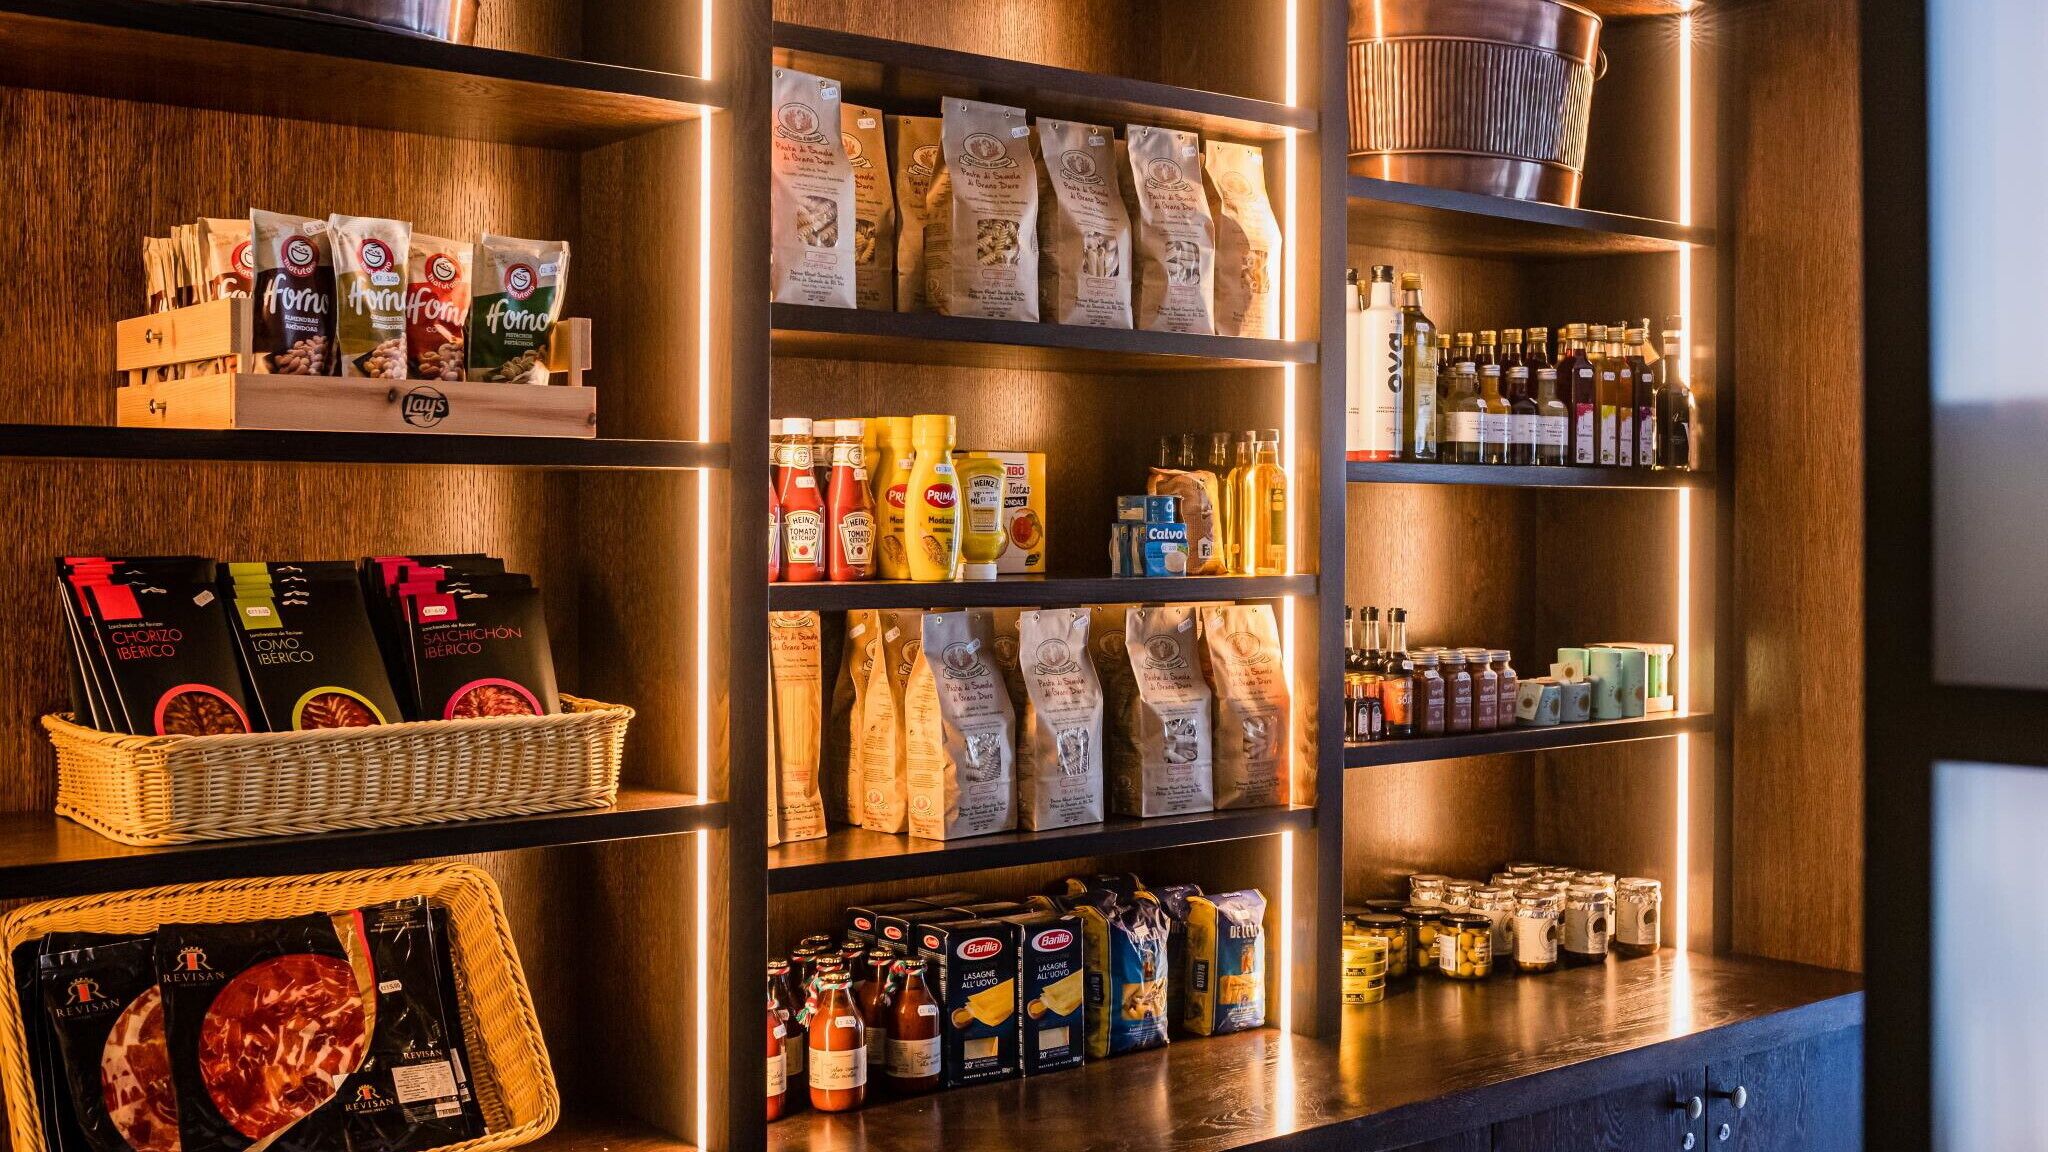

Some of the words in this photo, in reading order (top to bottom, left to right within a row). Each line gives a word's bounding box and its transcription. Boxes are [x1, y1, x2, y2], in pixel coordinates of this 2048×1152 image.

[973, 479, 995, 488] HEINZ
[927, 489, 957, 505] PRIMA
[792, 516, 815, 525] HEINZ
[849, 518, 870, 527] HEINZ
[790, 528, 817, 536] TOMATO
[847, 530, 871, 538] TOMATO
[1148, 527, 1183, 540] Calvo
[112, 628, 183, 645] CHORIZO
[423, 624, 522, 645] SALCHICHÓN
[252, 637, 300, 652] LOMO
[424, 641, 482, 660] IBÉRICO
[116, 643, 175, 660] IBÉRICO
[257, 649, 314, 666] IBÉRICO
[1041, 932, 1070, 946] Barilla
[967, 941, 999, 955] Barilla
[1038, 960, 1068, 973] LASAGNE
[162, 971, 226, 984] REVISAN
[963, 969, 996, 981] LASAGNE
[961, 977, 998, 989] ALL'UOVO
[55, 997, 121, 1018] REVISAN
[403, 1048, 443, 1061] REVISAN
[344, 1097, 395, 1112] REVISAN
